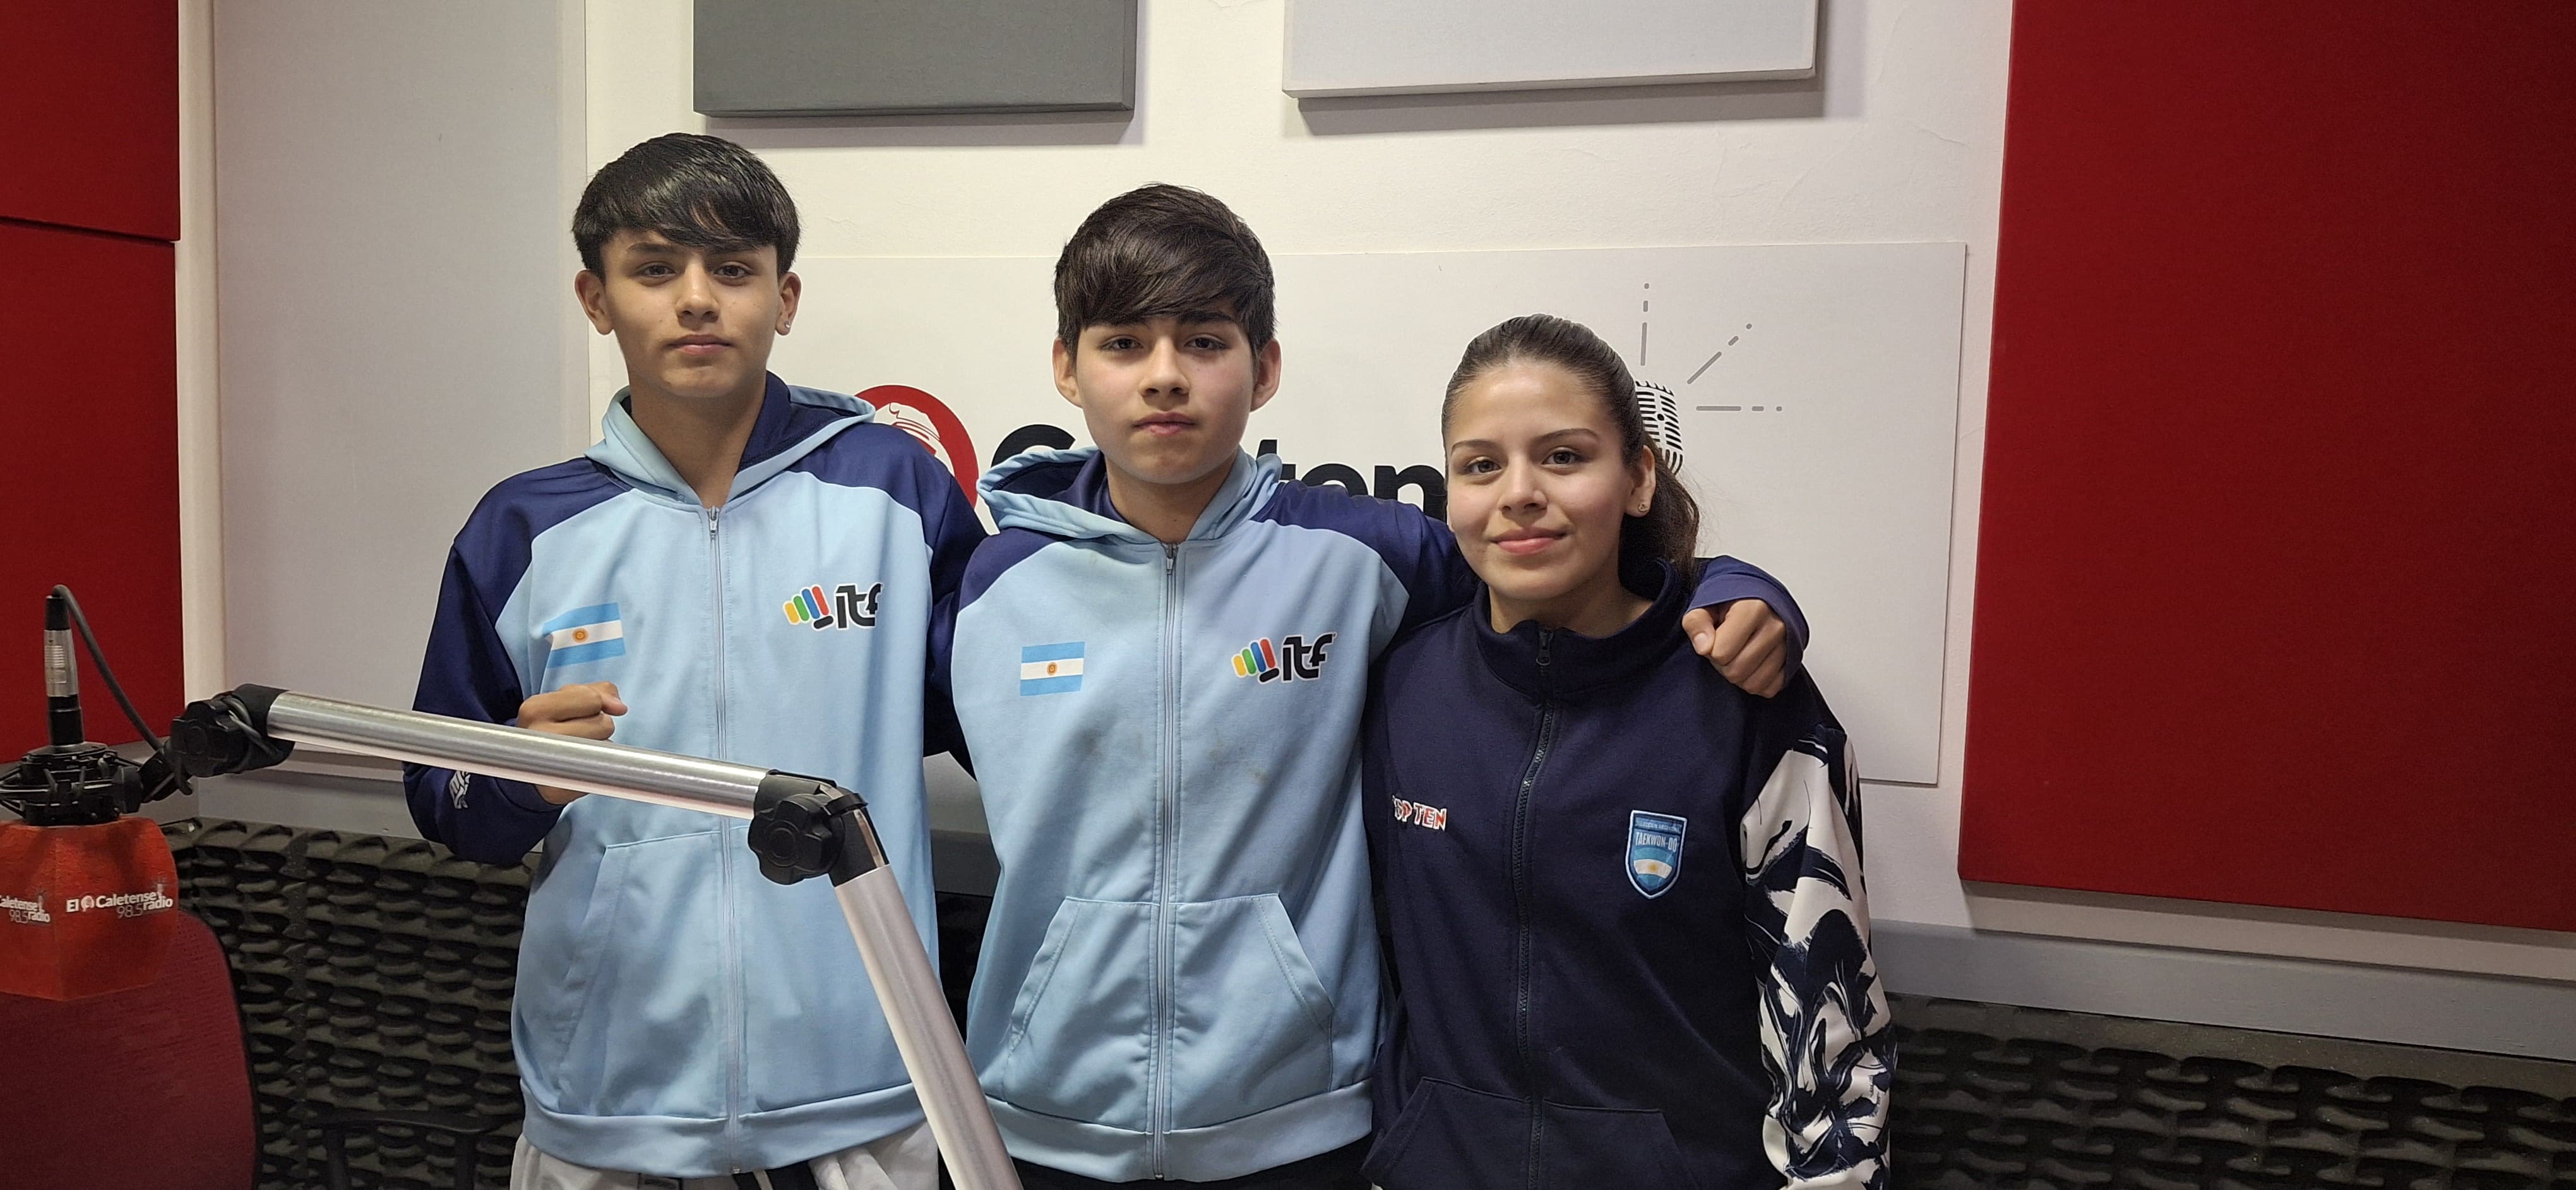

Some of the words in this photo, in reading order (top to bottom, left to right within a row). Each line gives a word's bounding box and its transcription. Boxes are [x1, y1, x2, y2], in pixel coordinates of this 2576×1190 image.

[1282, 633, 1333, 682] itf
[1392, 795, 1412, 822] OP
[1414, 802, 1446, 831] TEN
[1635, 832, 1678, 853] TAEKWON-DO
[0, 895, 39, 911] aletense
[66, 899, 80, 913] El
[96, 891, 157, 908] Caletense
[143, 894, 174, 911] radio
